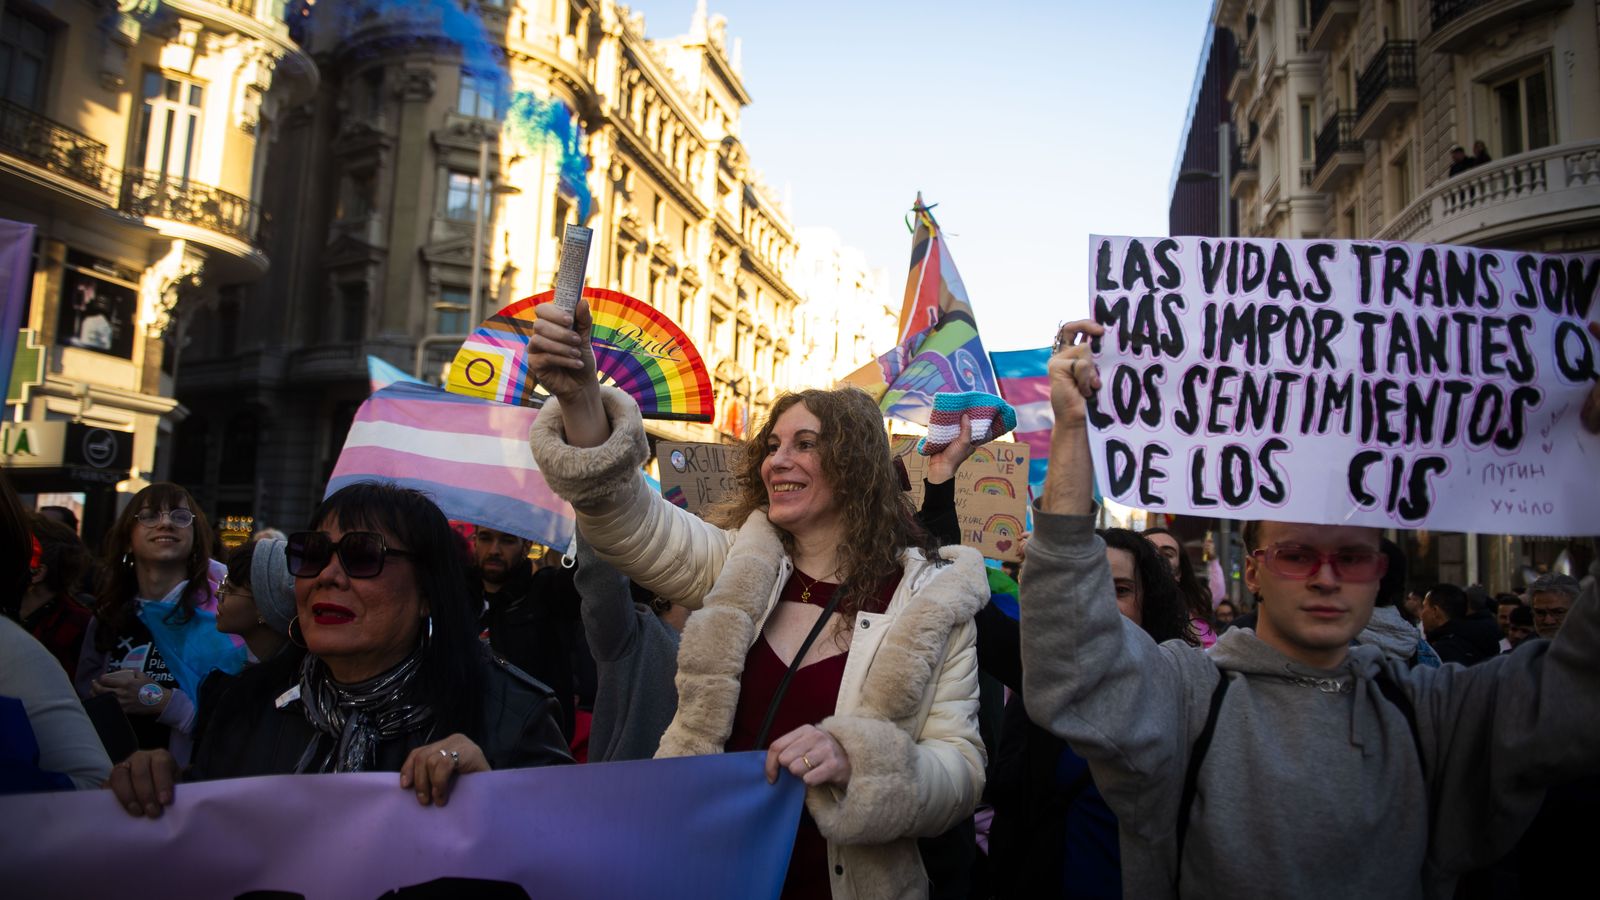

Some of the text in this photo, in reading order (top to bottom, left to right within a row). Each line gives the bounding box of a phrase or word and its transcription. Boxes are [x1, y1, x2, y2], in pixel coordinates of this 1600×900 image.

[1095, 238, 1600, 319] LAS VIDAS TRANS SON
[606, 324, 682, 358] Pride
[1174, 364, 1541, 450] SENTIMIENTOS
[696, 476, 713, 506] DE
[1106, 437, 1447, 520] DE LOS CIS
[1482, 462, 1545, 486] ПУТИН
